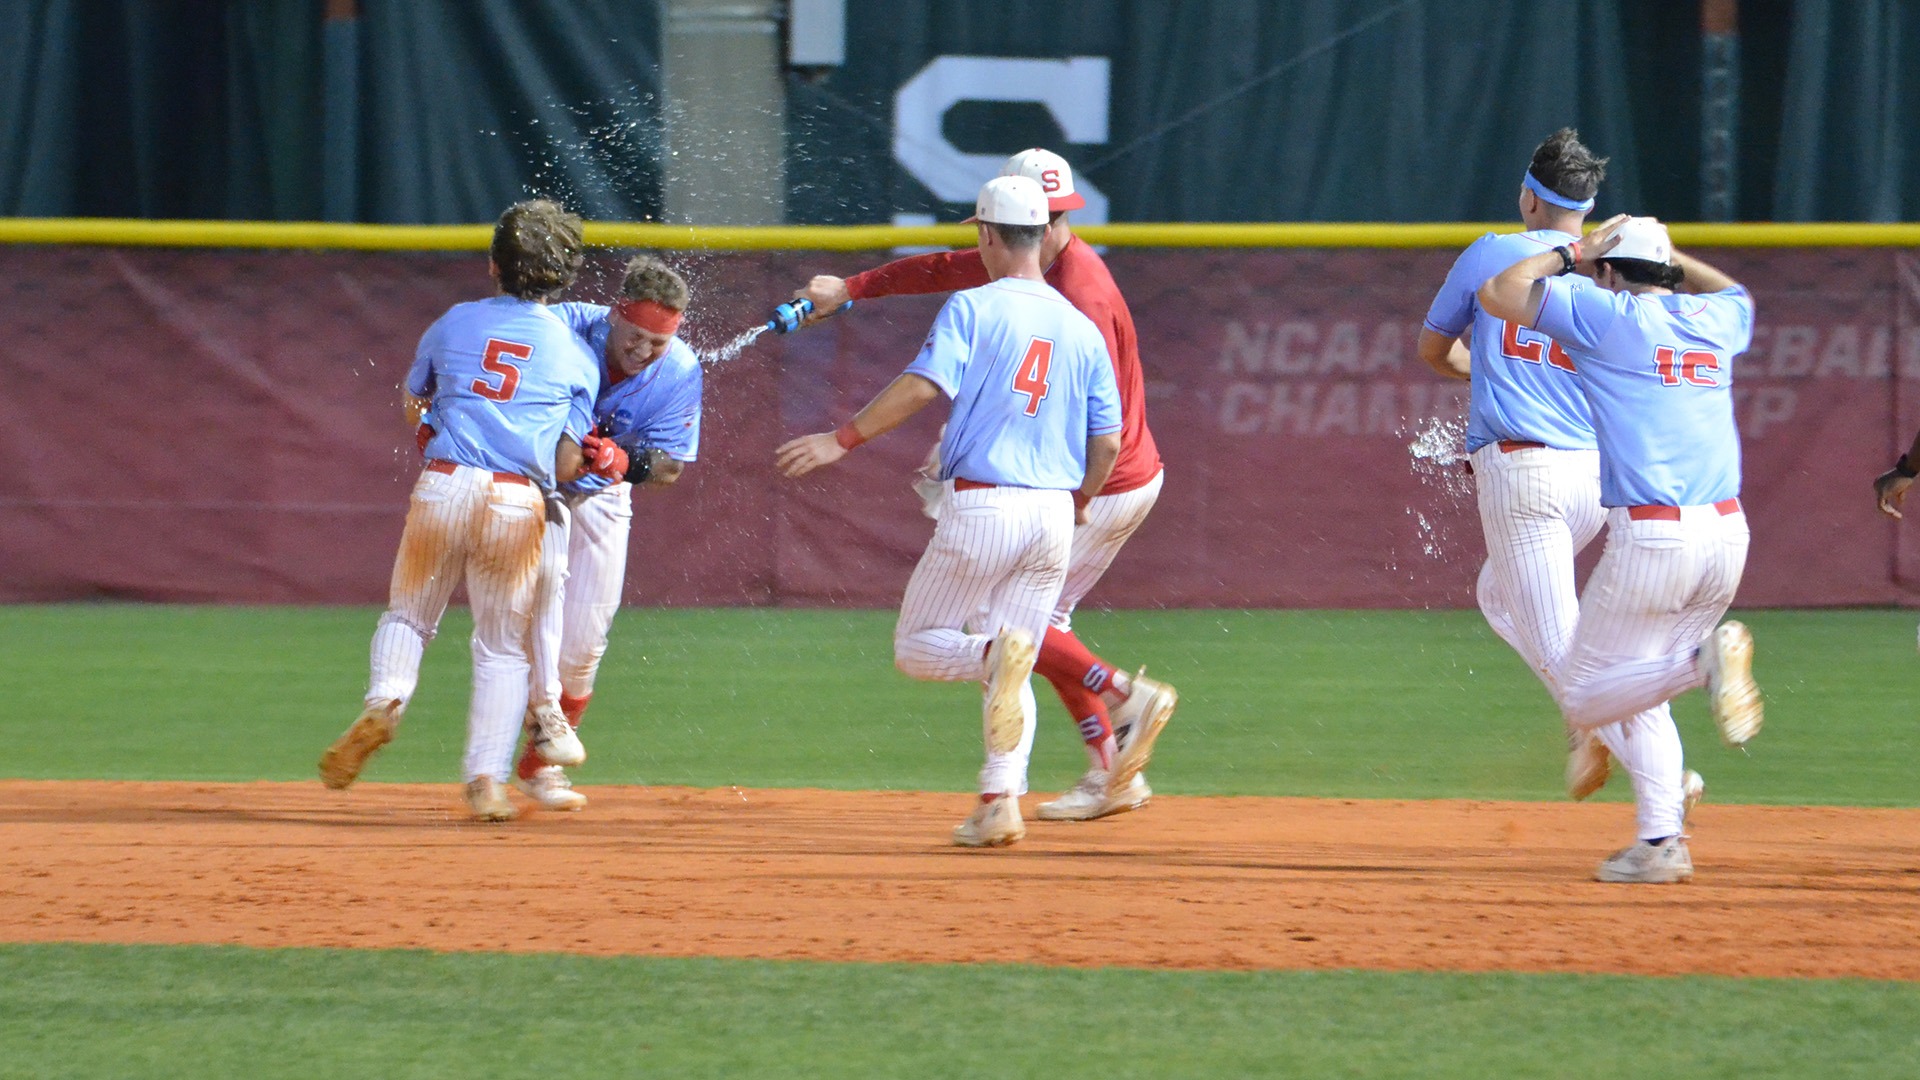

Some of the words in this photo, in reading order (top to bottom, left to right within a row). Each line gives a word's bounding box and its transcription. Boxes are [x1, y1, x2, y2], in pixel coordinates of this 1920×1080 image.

[1041, 169, 1061, 193] S
[470, 337, 535, 404] 5
[1219, 321, 1404, 374] NCAA
[1011, 335, 1055, 418] 4
[1082, 662, 1110, 693] S
